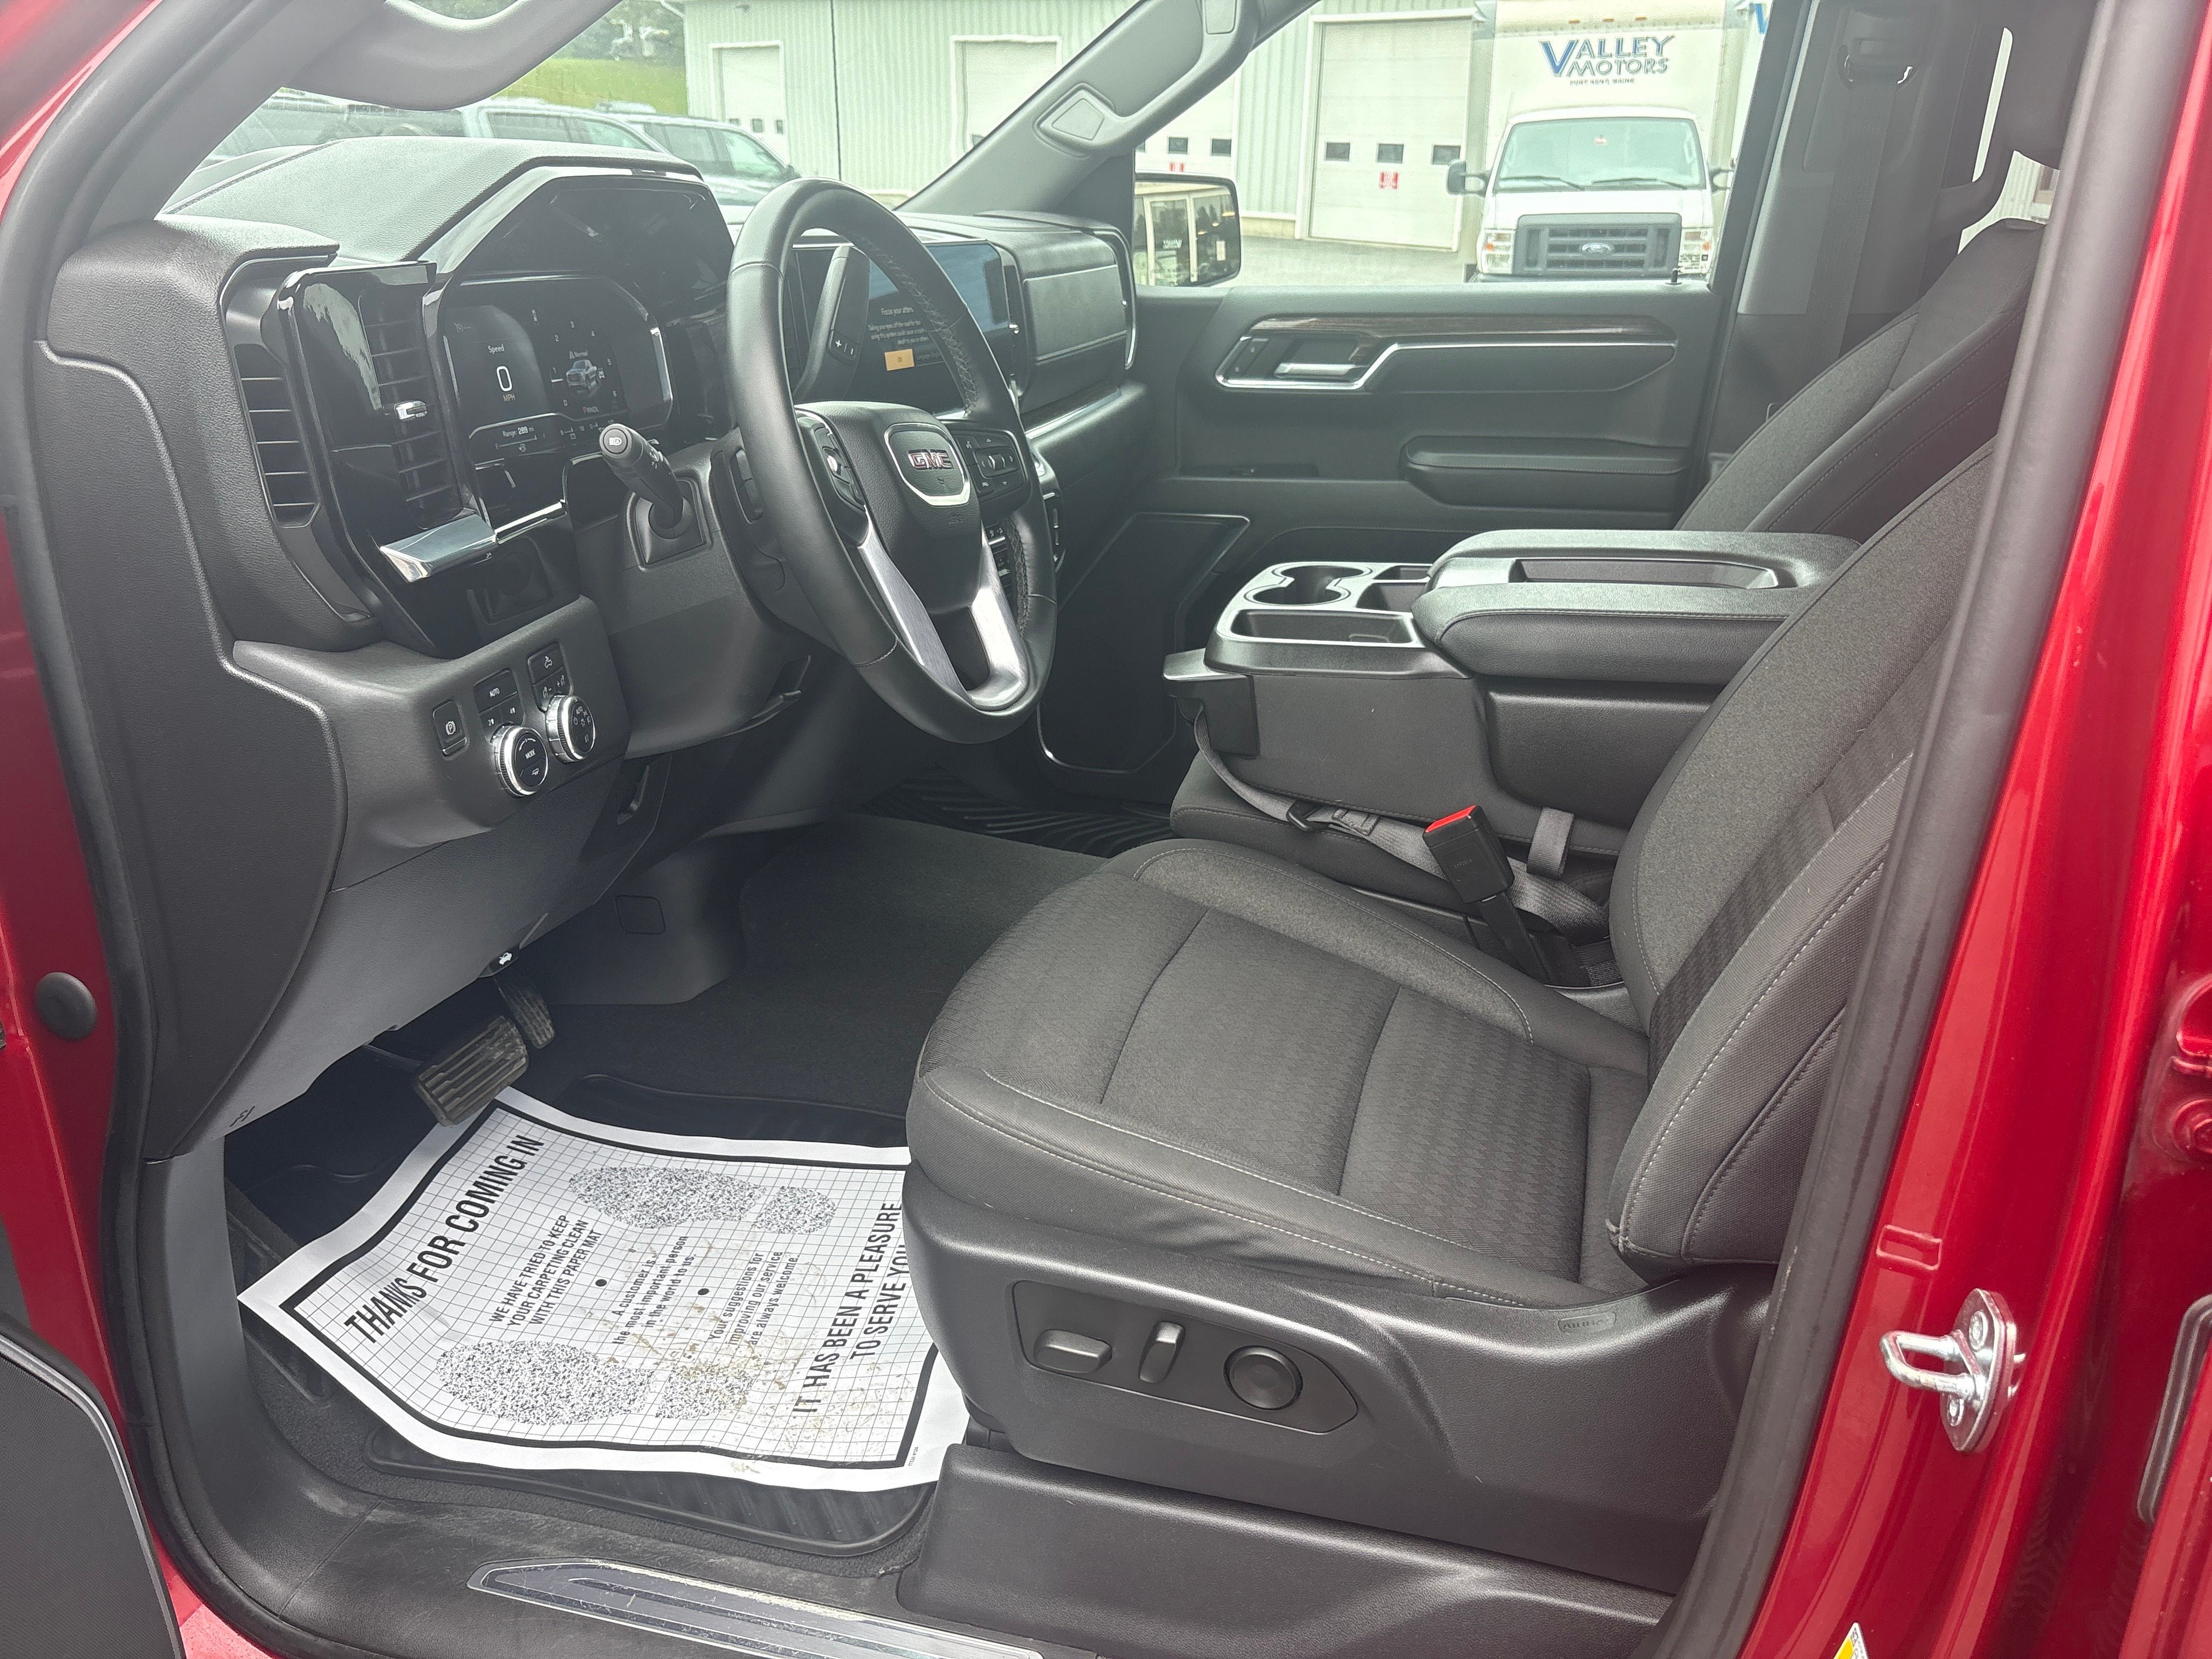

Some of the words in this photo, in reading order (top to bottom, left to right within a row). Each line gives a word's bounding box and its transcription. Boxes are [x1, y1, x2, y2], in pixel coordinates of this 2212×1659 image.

[1538, 35, 1675, 77] VALLEY
[1566, 58, 1669, 77] MOTORS
[488, 344, 505, 355] Speed
[496, 366, 512, 392] 0
[503, 394, 516, 402] MPH
[908, 449, 953, 470] GMC
[489, 688, 500, 697] AUTO
[525, 749, 537, 759] MODE
[344, 1278, 427, 1343] THANKS
[406, 1235, 466, 1283] FOR
[445, 1155, 528, 1233] COMING
[506, 1135, 545, 1156] IN
[850, 1203, 902, 1283] PLEASURE
[489, 1306, 510, 1322] WE
[501, 1280, 528, 1305] HAVE
[519, 1252, 546, 1278] TRIED
[538, 1240, 555, 1250] TO
[548, 1215, 569, 1239] KEEP
[507, 1301, 535, 1325] YOUR
[527, 1249, 569, 1299] CARPETING
[562, 1220, 589, 1248] CLEAN
[529, 1301, 555, 1324] WITH
[547, 1278, 571, 1299] THIS
[562, 1249, 590, 1276] PAPER
[581, 1229, 602, 1248] MAT
[612, 1331, 630, 1344] the
[625, 1308, 646, 1328] most
[636, 1266, 672, 1305] important
[665, 1236, 689, 1263] person
[619, 1269, 650, 1308] customer
[648, 1304, 666, 1317] the
[660, 1279, 682, 1301] world
[708, 1319, 729, 1340] Your
[723, 1267, 757, 1317] suggestions
[749, 1253, 764, 1264] for
[726, 1300, 760, 1345] improving
[752, 1284, 766, 1297] our
[760, 1252, 782, 1282] service
[749, 1331, 762, 1345] are
[756, 1298, 779, 1328] always
[772, 1255, 799, 1295] welcome.
[845, 1289, 870, 1300] A
[823, 1306, 862, 1347] BEEN
[864, 1283, 906, 1335] SERVE
[850, 1340, 881, 1359] TO
[803, 1353, 840, 1388] HAS
[792, 1396, 822, 1413] IT
